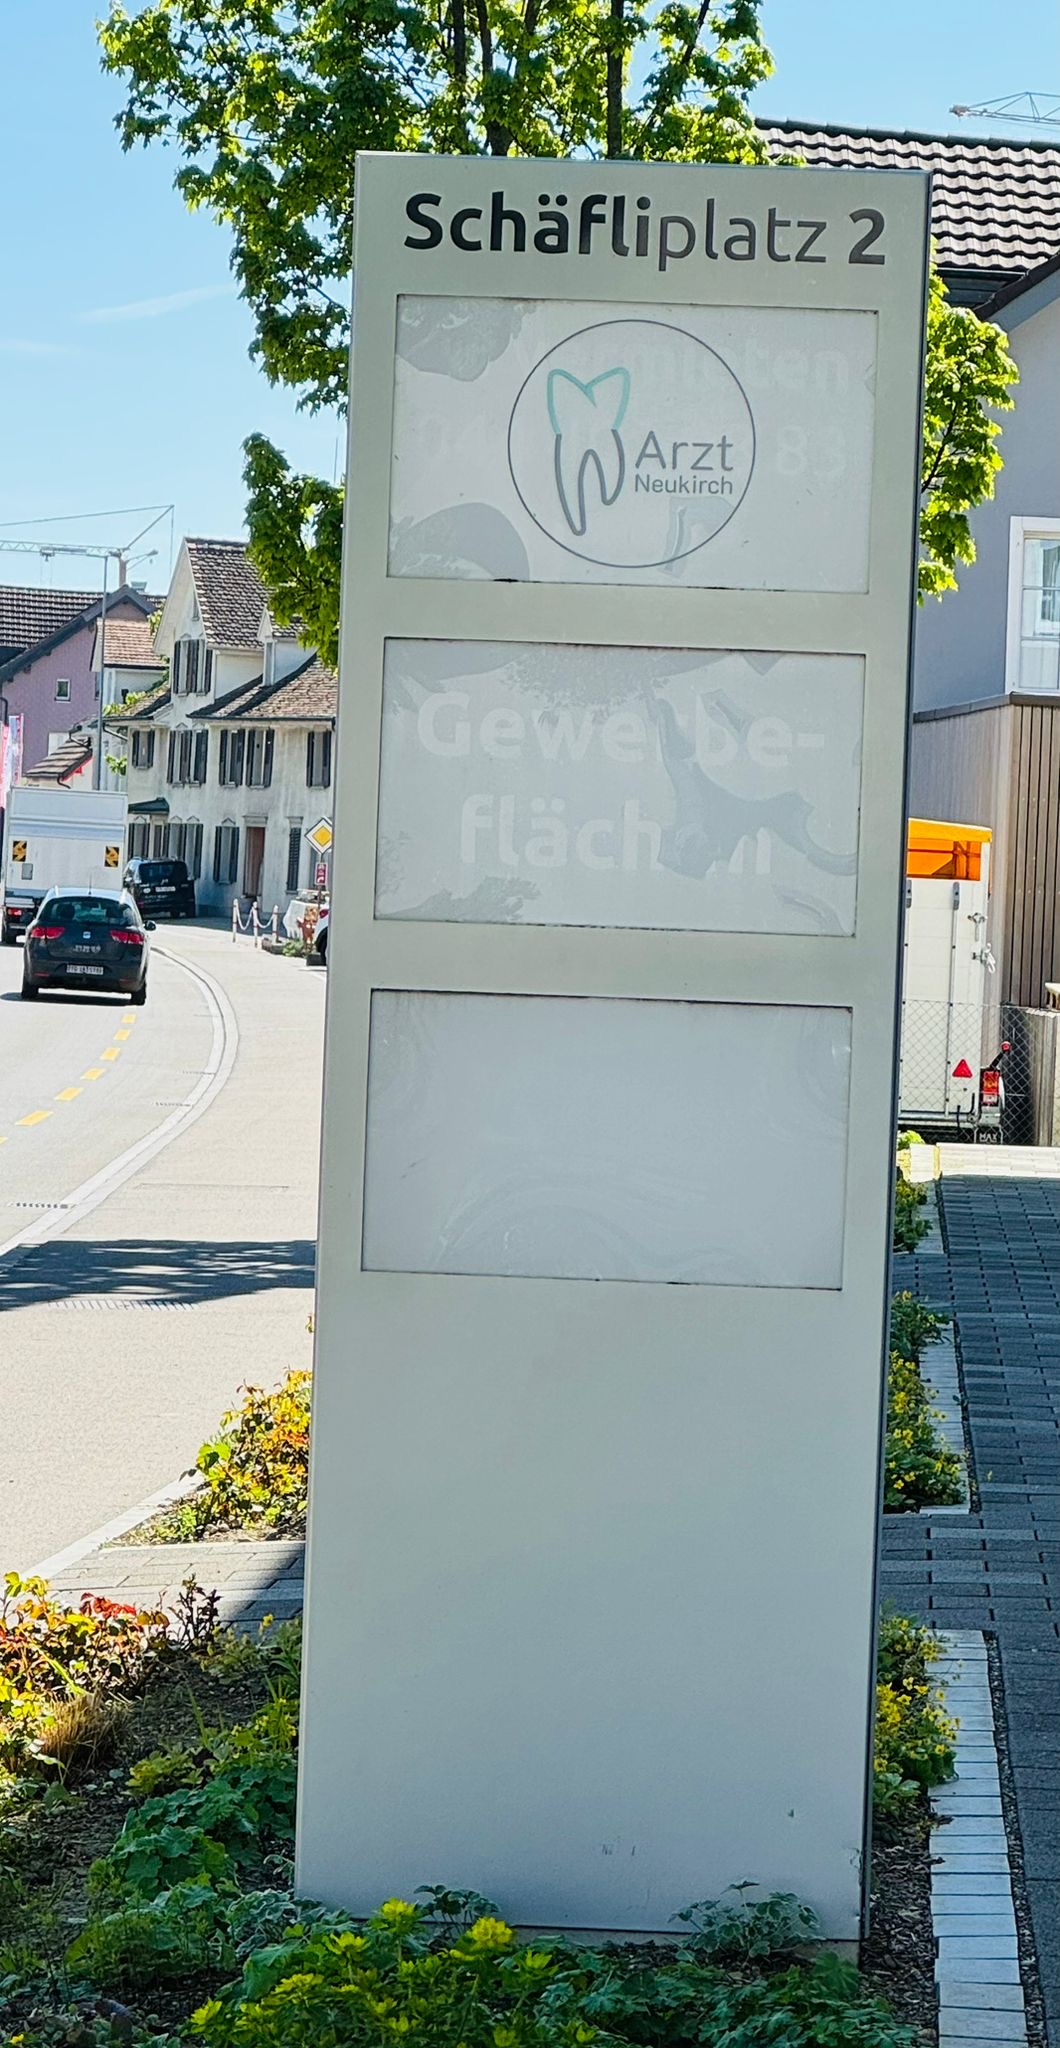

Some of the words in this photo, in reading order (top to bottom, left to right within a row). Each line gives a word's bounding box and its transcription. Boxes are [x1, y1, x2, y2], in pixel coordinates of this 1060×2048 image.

[403, 190, 828, 272] Schäfliplatz
[847, 208, 886, 265] 2
[634, 430, 735, 472] Arzt
[634, 474, 734, 496] Neukirch
[460, 793, 773, 875] flächn
